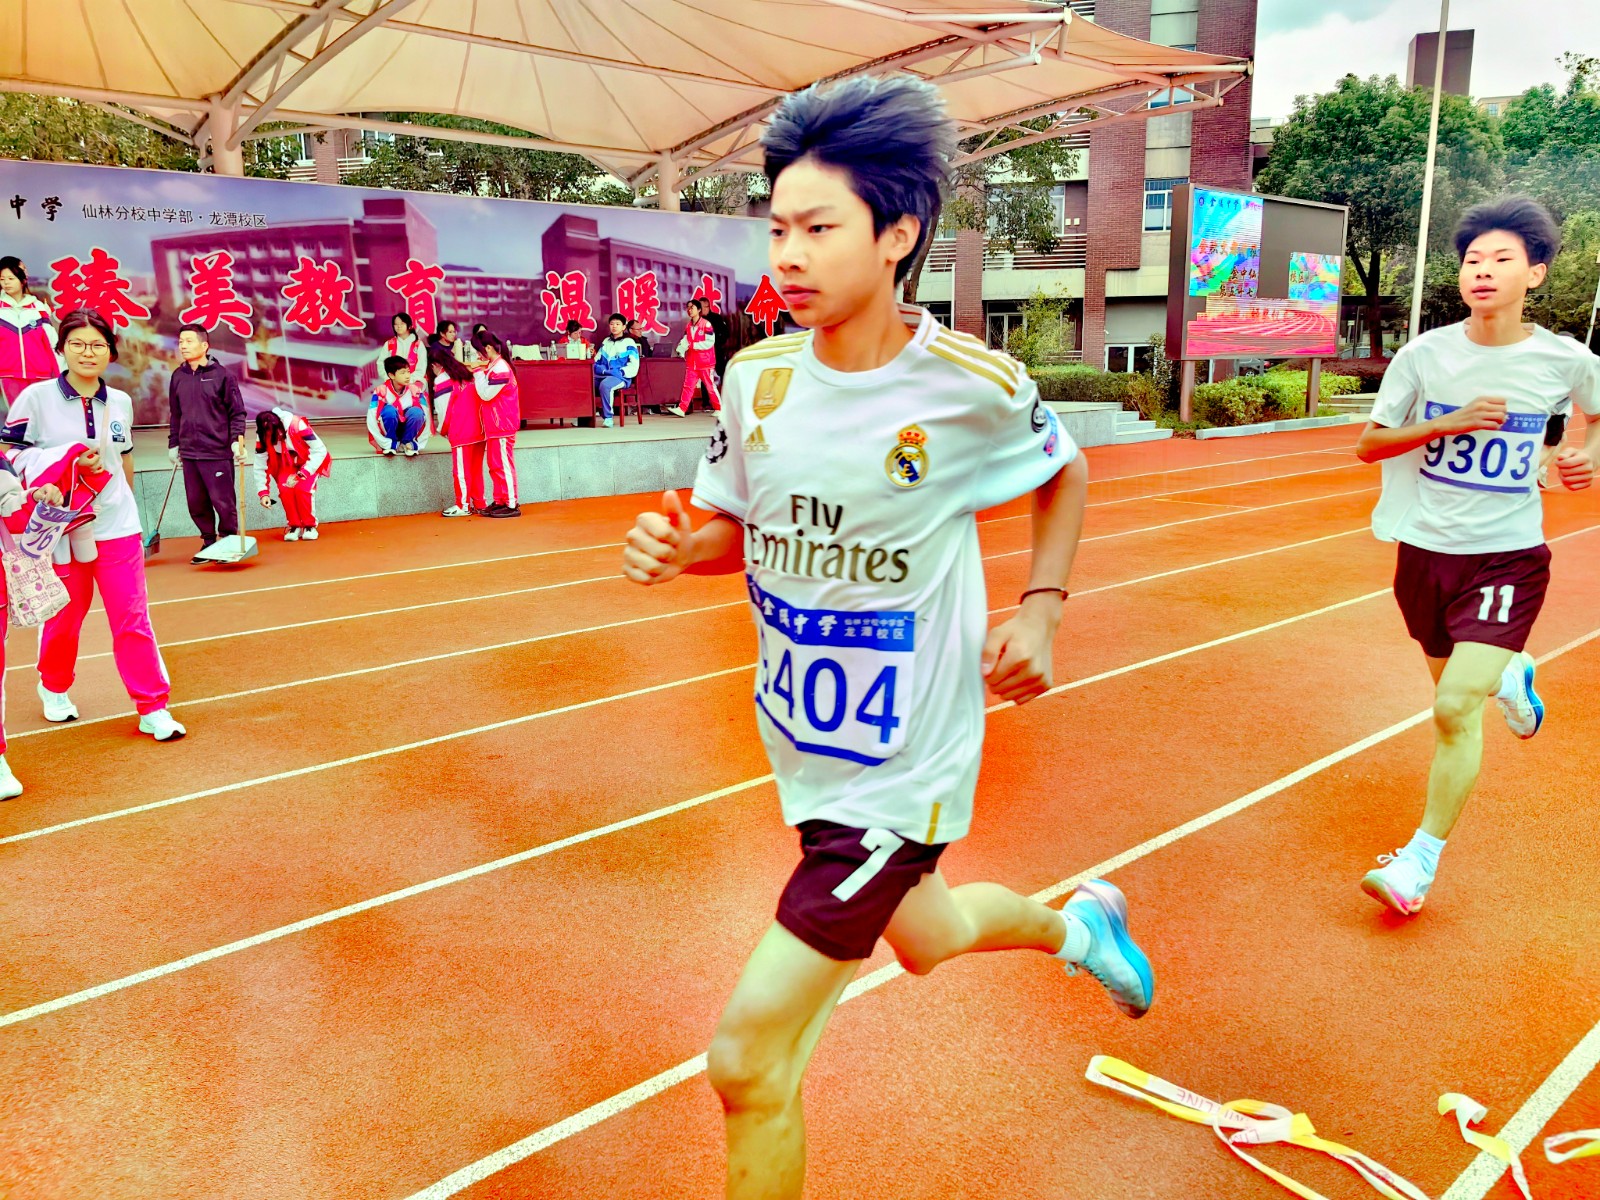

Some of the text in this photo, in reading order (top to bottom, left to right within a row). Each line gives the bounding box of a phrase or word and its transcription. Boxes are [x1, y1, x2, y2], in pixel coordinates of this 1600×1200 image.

[10, 194, 62, 222] 中学
[1424, 434, 1535, 480] 9303
[790, 495, 843, 535] Fly
[745, 523, 909, 583] Emirates
[1478, 584, 1514, 623] 11
[761, 624, 900, 744] 404
[831, 827, 905, 902] 7
